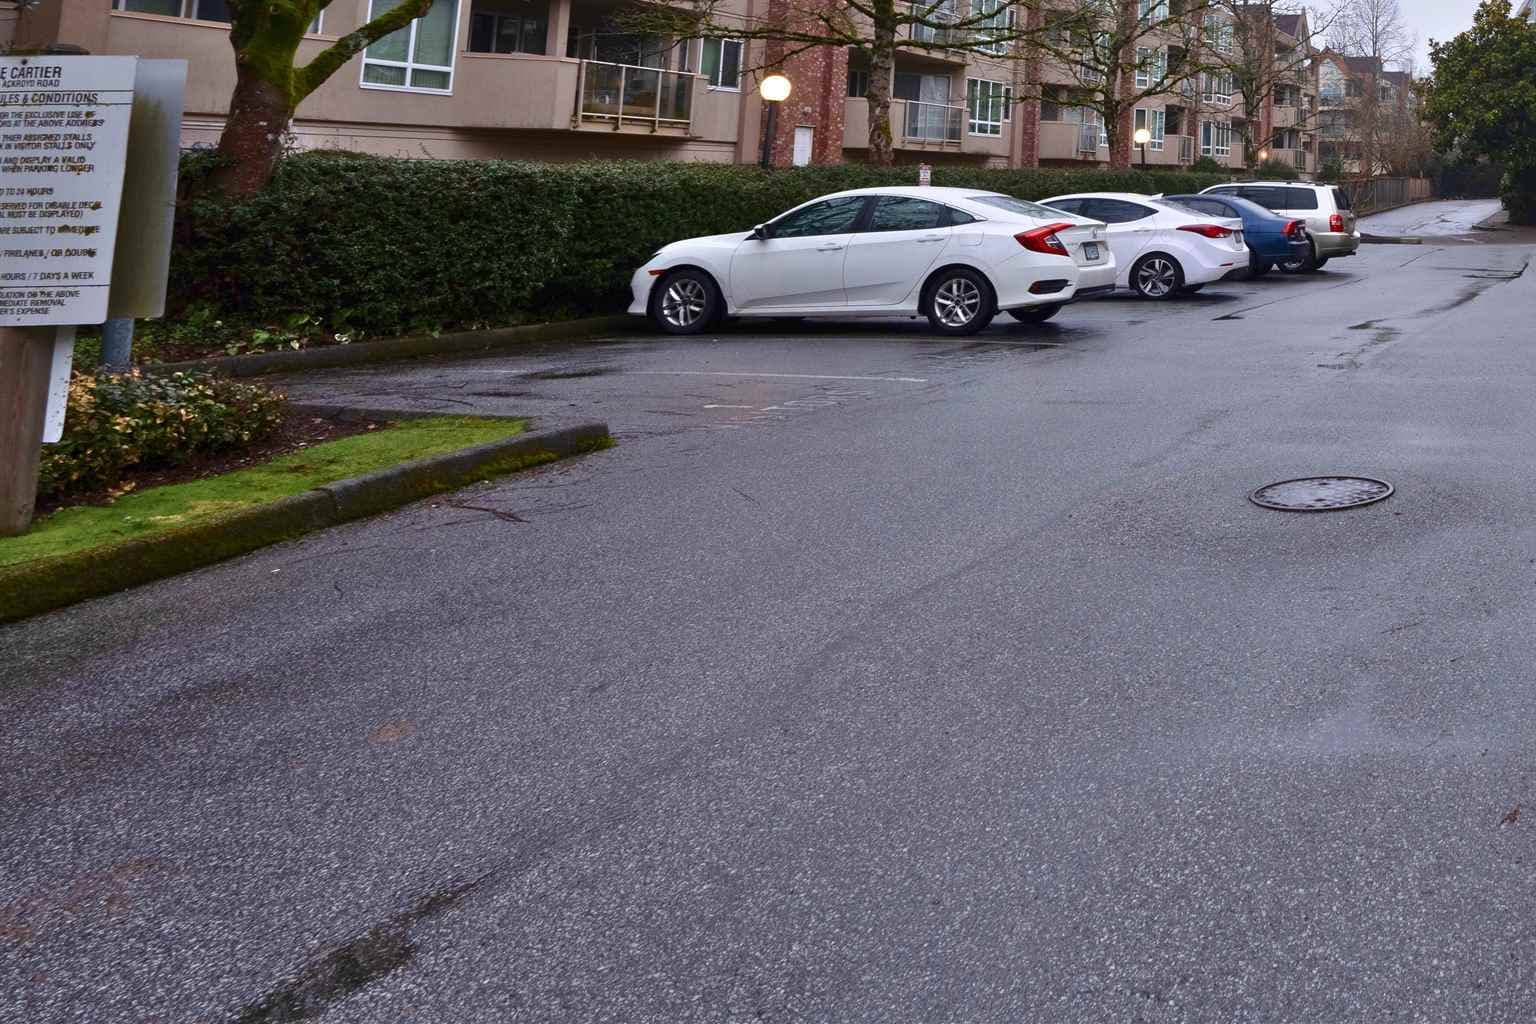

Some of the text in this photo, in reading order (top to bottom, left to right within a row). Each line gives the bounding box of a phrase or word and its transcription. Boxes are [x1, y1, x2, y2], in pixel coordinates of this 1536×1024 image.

[10, 66, 62, 79] CARTIER
[2, 79, 60, 88] ACKROYD ROAD
[22, 94, 29, 104] &
[31, 92, 98, 104] CONDITIONS
[11, 111, 23, 119] THE
[25, 111, 64, 119] EXCLUSIVE
[63, 133, 92, 141] STALLS
[43, 142, 72, 150] STALLS
[75, 142, 96, 150] ONLY
[4, 156, 18, 164] AND
[20, 156, 51, 164] DISPLAY
[60, 164, 94, 172] LONGER
[27, 187, 54, 195] HOURS
[45, 201, 77, 209] DISABLE
[28, 210, 38, 218] BE
[46, 226, 56, 234] TO
[63, 272, 70, 280] A
[17, 307, 49, 315] EXPENSE
